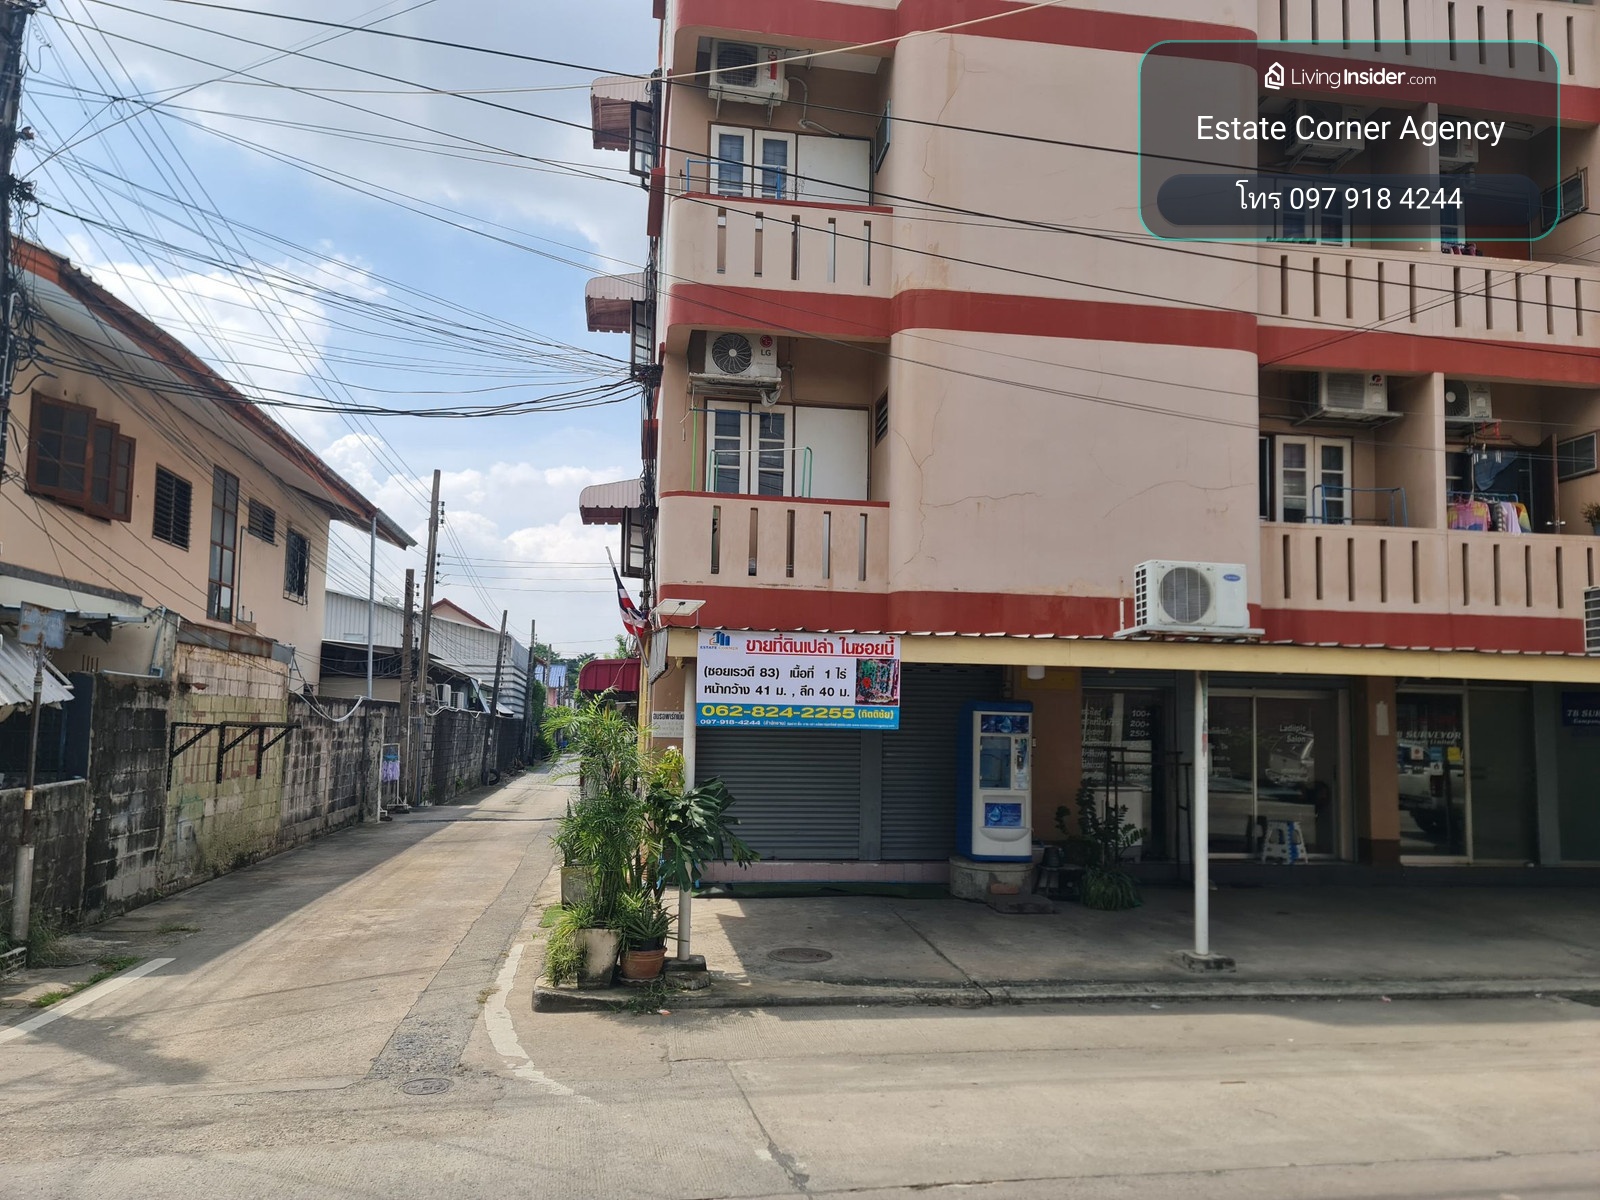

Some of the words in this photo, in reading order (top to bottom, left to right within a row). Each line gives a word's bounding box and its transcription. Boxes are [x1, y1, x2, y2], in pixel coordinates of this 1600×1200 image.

[760, 349, 772, 357] LG
[746, 634, 834, 655] ขายที่ดินเปล่า
[840, 636, 895, 656] ในซอยนี้
[703, 665, 755, 680] (ซอยเรวดี
[759, 667, 780, 680] 83)
[789, 664, 815, 680] เนื้อที่
[825, 669, 831, 680] 1
[835, 667, 847, 680] ไร่
[704, 683, 750, 696] หน้ากว้าง
[755, 685, 771, 696] 41
[776, 687, 787, 697] ม.
[800, 684, 815, 697] ลึก
[819, 686, 835, 697] 40
[840, 688, 850, 698] ม.
[701, 705, 856, 719] 062-824-2255
[1286, 735, 1306, 743] Salon
[1406, 730, 1462, 739] SURVEYOR
